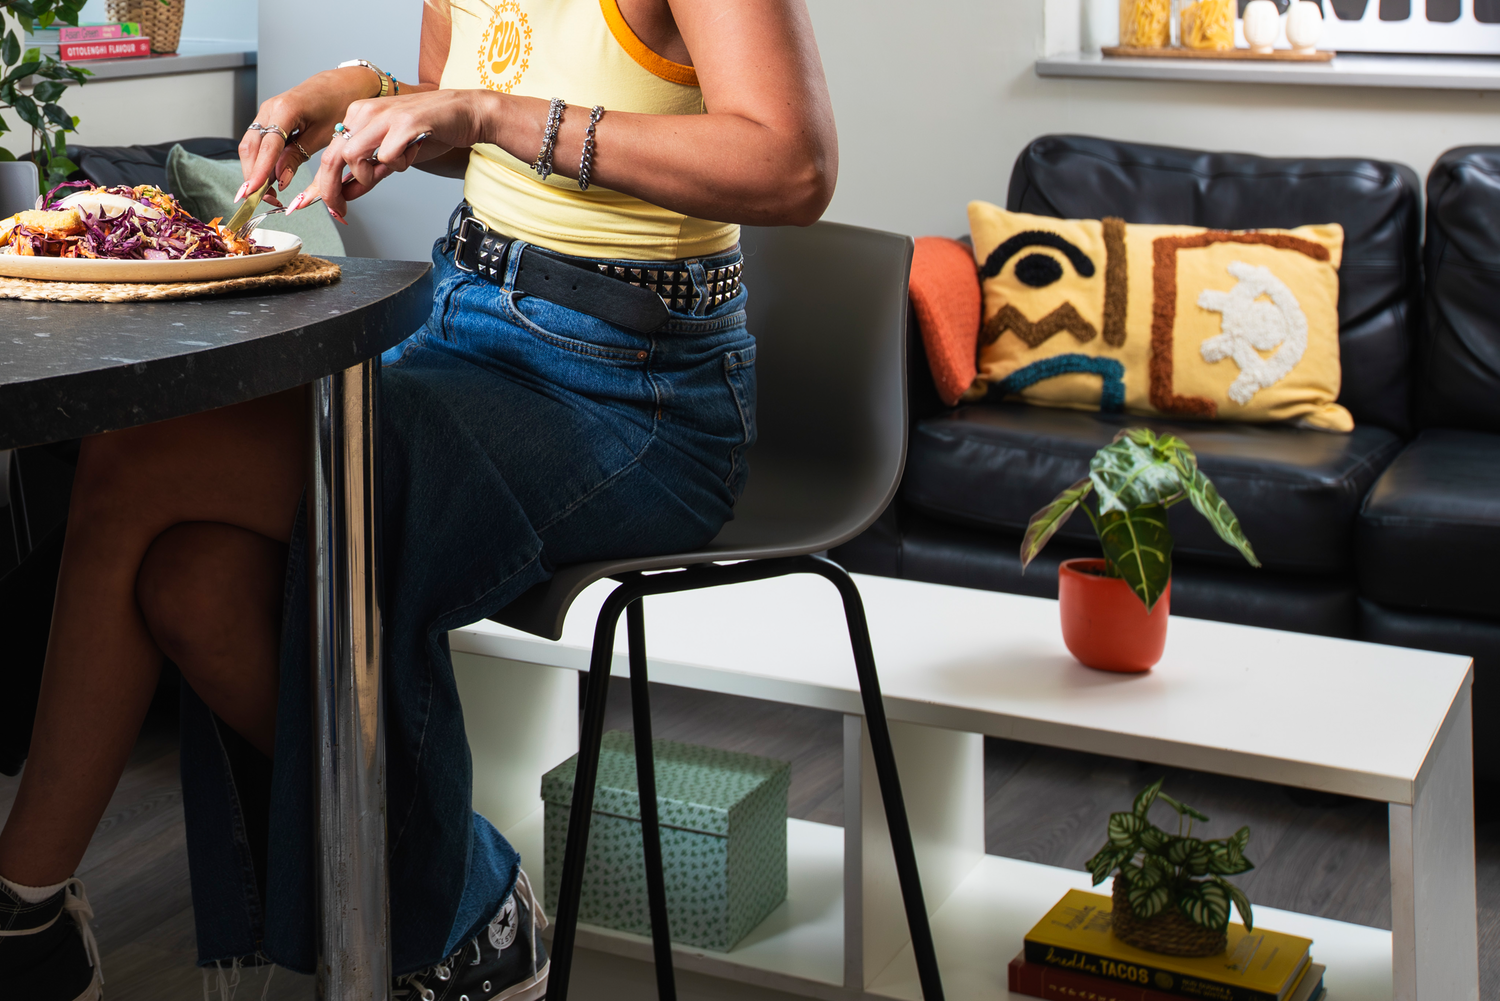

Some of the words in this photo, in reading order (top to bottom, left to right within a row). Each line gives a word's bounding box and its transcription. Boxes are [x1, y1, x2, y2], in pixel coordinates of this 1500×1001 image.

[67, 45, 107, 57] OTTOLENGHI
[109, 43, 136, 54] FLAVOUR
[487, 20, 521, 74] FILA
[1100, 959, 1149, 985] TACOS
